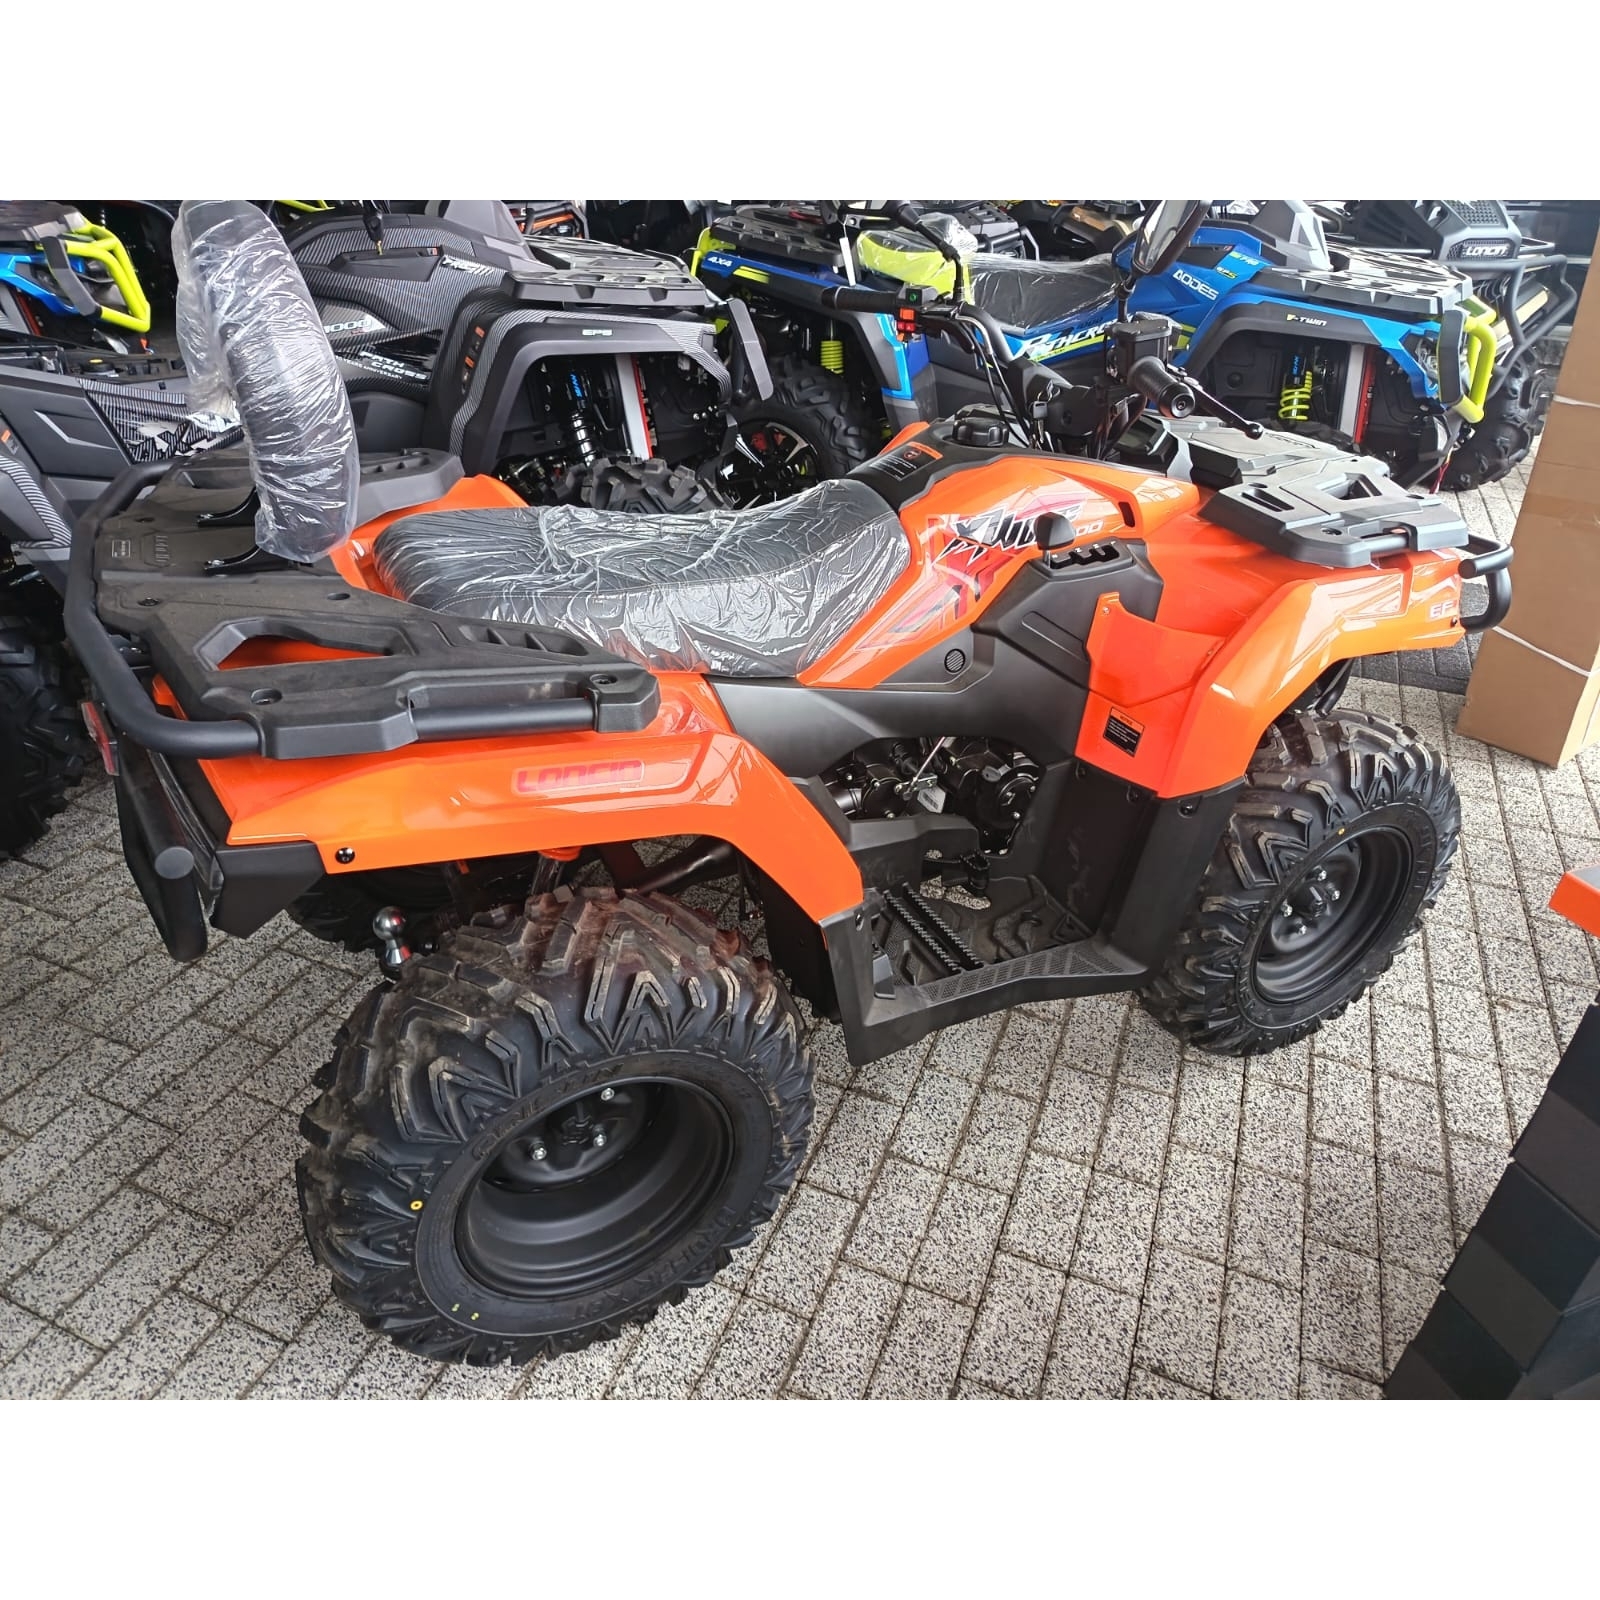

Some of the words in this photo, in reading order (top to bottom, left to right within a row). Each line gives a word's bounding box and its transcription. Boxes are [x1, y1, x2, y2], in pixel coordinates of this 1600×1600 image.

[1466, 246, 1507, 256] LONCIN
[1172, 268, 1219, 301] AODES
[582, 328, 613, 336] EPS
[360, 351, 405, 368] PATH
[371, 361, 428, 380] CROSS
[517, 759, 643, 793] LONCIN
